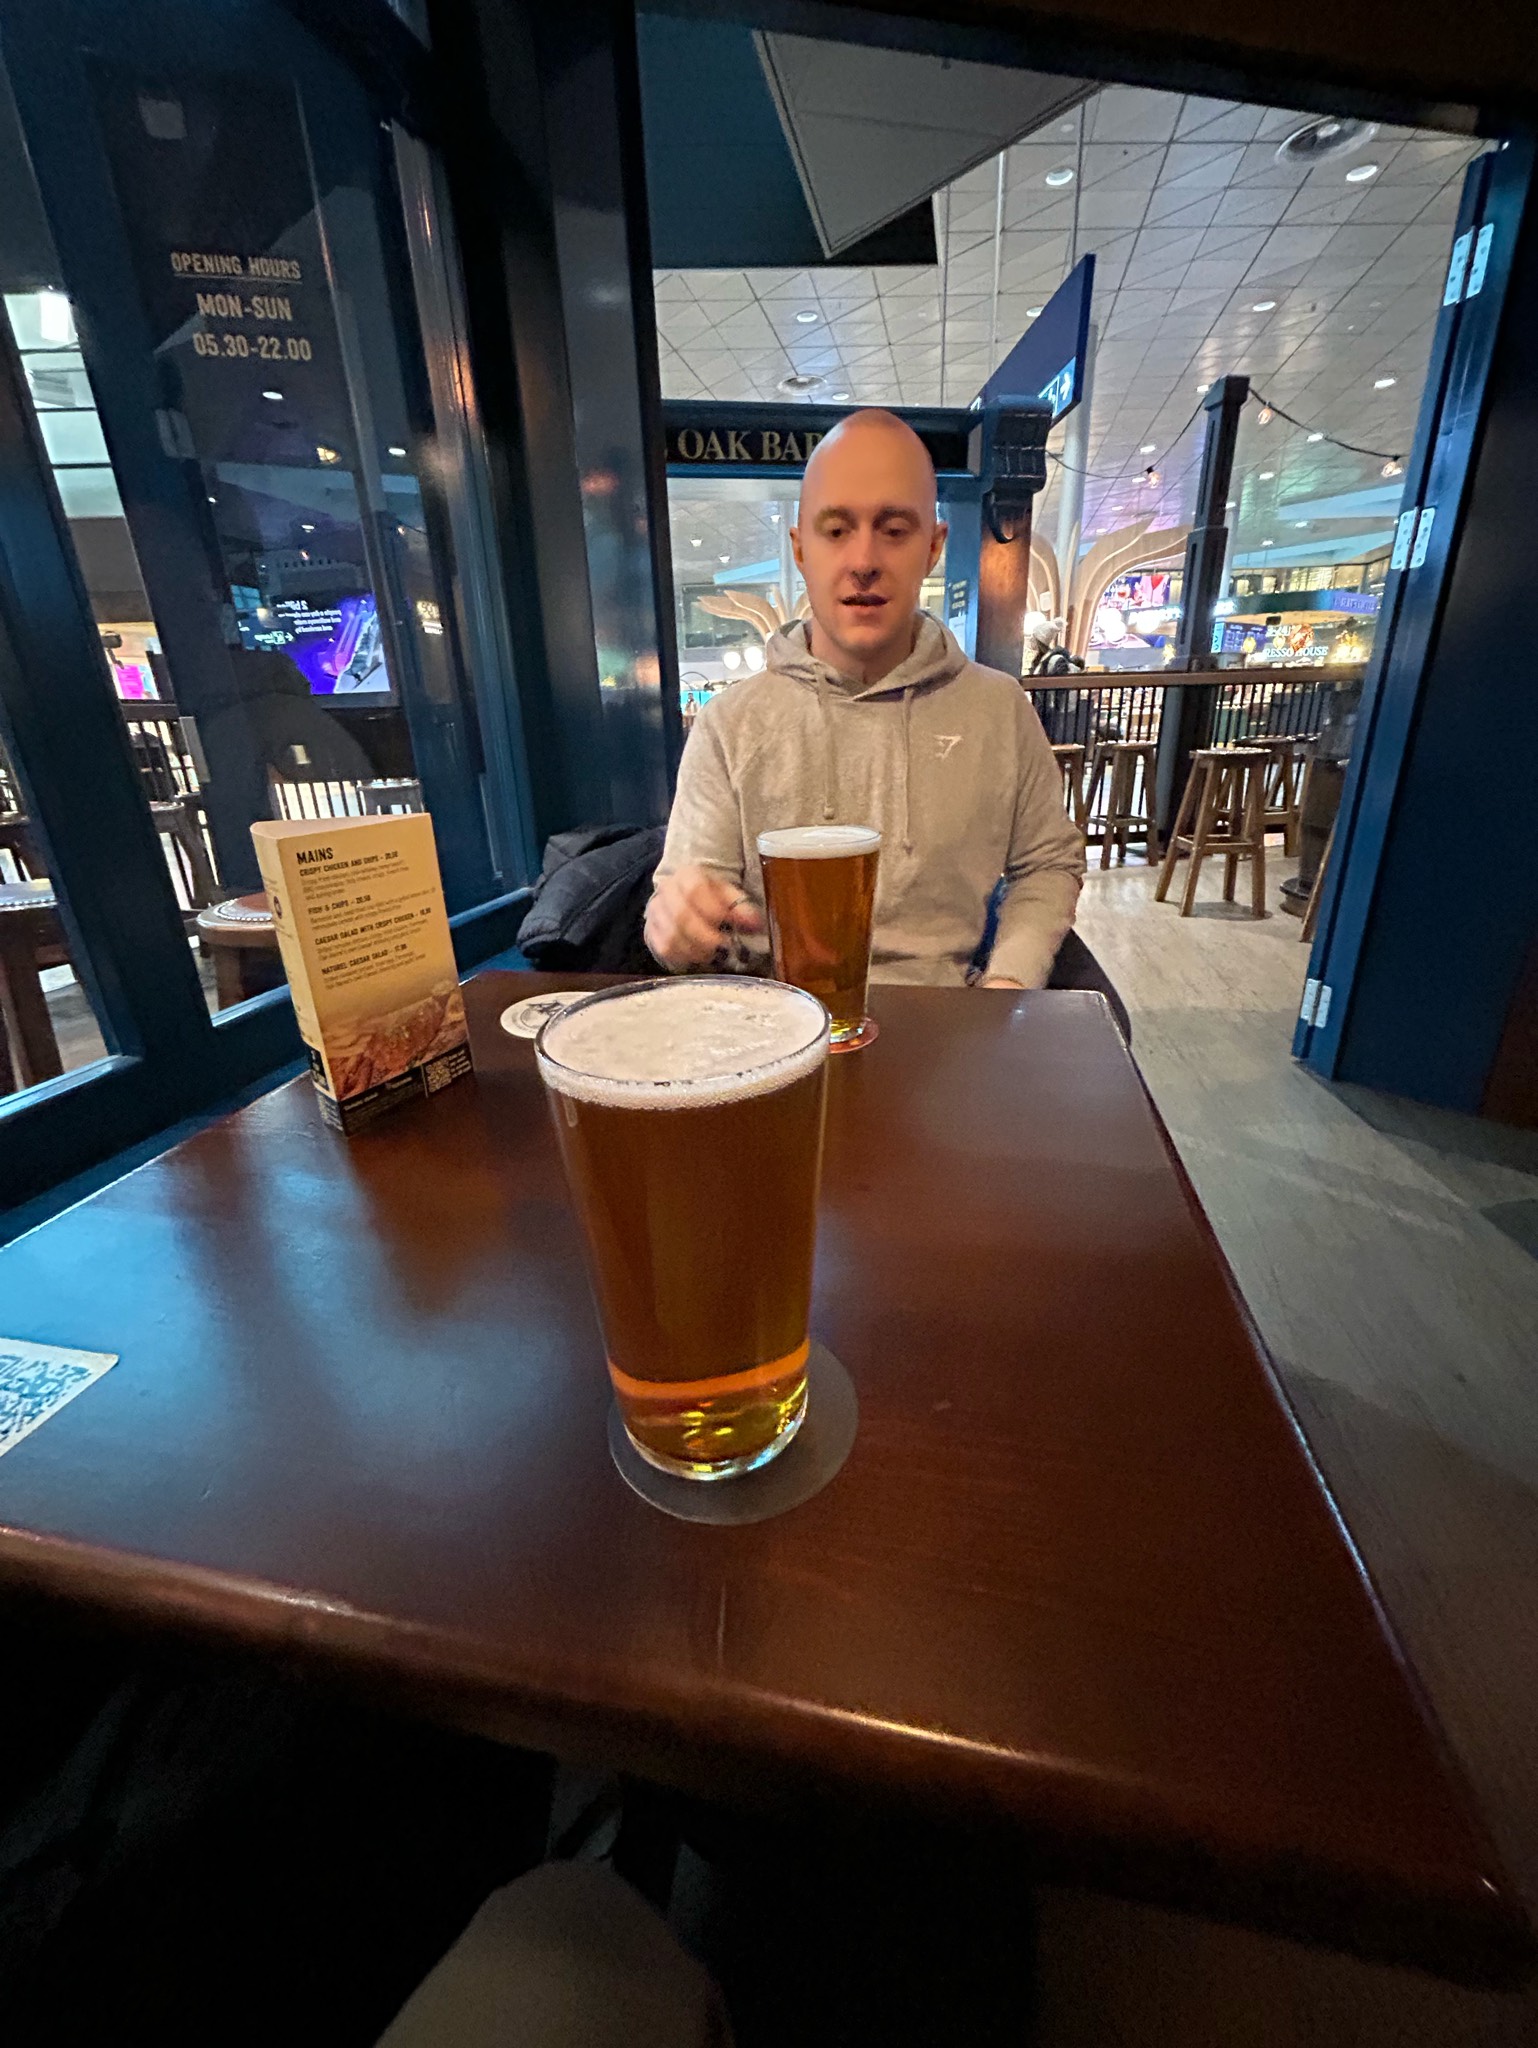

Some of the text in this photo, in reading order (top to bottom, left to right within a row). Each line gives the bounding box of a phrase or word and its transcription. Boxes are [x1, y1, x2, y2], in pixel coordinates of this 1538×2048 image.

[171, 252, 302, 280] OPENING HOURS
[196, 293, 293, 321] MON-SUN
[192, 332, 313, 361] 05.30-22.00
[677, 428, 752, 460] OAK
[296, 847, 334, 865] MAINS
[299, 865, 321, 877] CRISPY
[323, 861, 349, 872] CHICKEN
[351, 859, 363, 867] AND
[315, 933, 338, 945] CAESAR
[340, 928, 359, 939] SALAD
[360, 924, 374, 933] WITH
[375, 919, 393, 929] CRISPY
[394, 913, 415, 924] CHICKEN
[349, 955, 370, 967] CAESAR
[372, 949, 388, 960] SALAD
